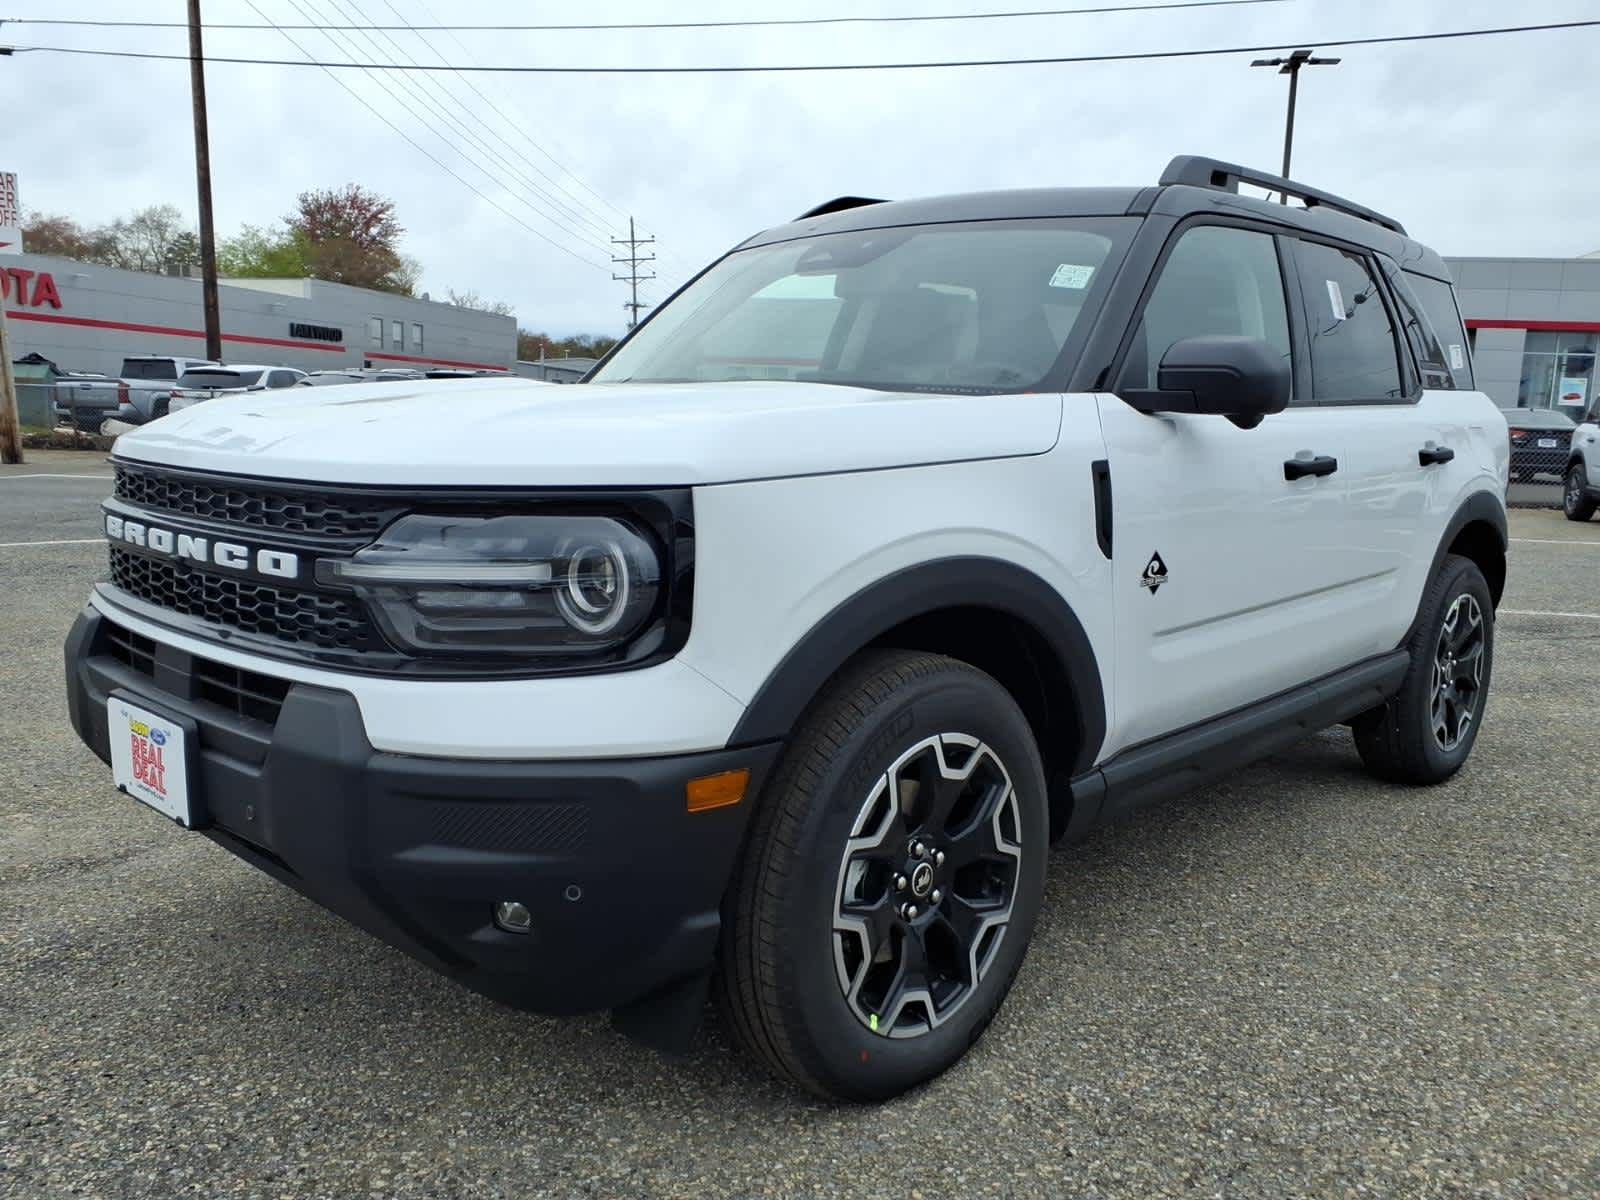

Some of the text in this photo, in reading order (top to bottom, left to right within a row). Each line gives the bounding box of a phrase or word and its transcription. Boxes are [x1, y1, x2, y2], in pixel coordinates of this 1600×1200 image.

[106, 514, 298, 579] BRONCO
[131, 733, 166, 771] REAL
[133, 758, 167, 796] DEAL
